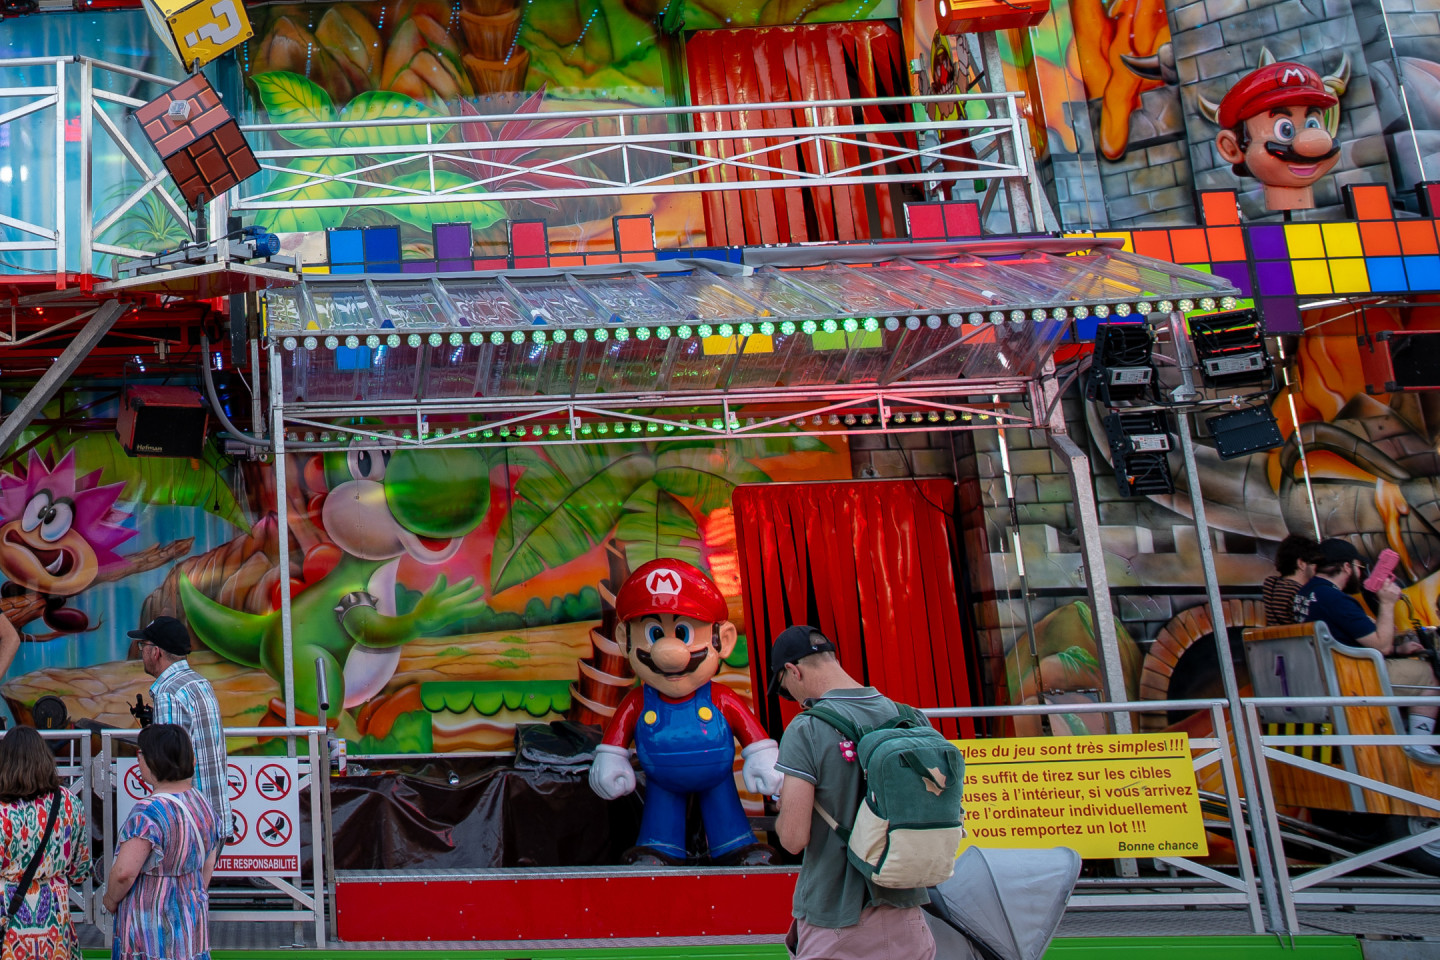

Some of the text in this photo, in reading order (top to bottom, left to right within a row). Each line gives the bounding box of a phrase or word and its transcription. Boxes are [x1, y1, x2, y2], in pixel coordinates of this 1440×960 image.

[991, 745, 1009, 757] du
[1013, 744, 1035, 759] jeu
[1040, 743, 1072, 755] sont
[1076, 741, 1104, 754] très
[1108, 739, 1165, 755] simples
[982, 771, 1018, 784] suffit
[1022, 770, 1039, 783] de
[1042, 770, 1074, 782] tirez
[1077, 770, 1100, 781] sur
[1104, 767, 1125, 780] les
[1129, 766, 1172, 779] cibles
[1002, 788, 1010, 801] à
[1013, 786, 1085, 801] l'intérieur,
[1088, 786, 1101, 799] si
[1105, 787, 1140, 798] vous
[1144, 784, 1193, 797] arrivez
[984, 805, 1065, 820] l'ordinateur
[1069, 802, 1188, 817] individuellement
[972, 820, 1147, 838] vous remportez un lot !!!
[1118, 840, 1199, 851] Bonne chance
[233, 856, 297, 869] RESPONSABILITÉ
